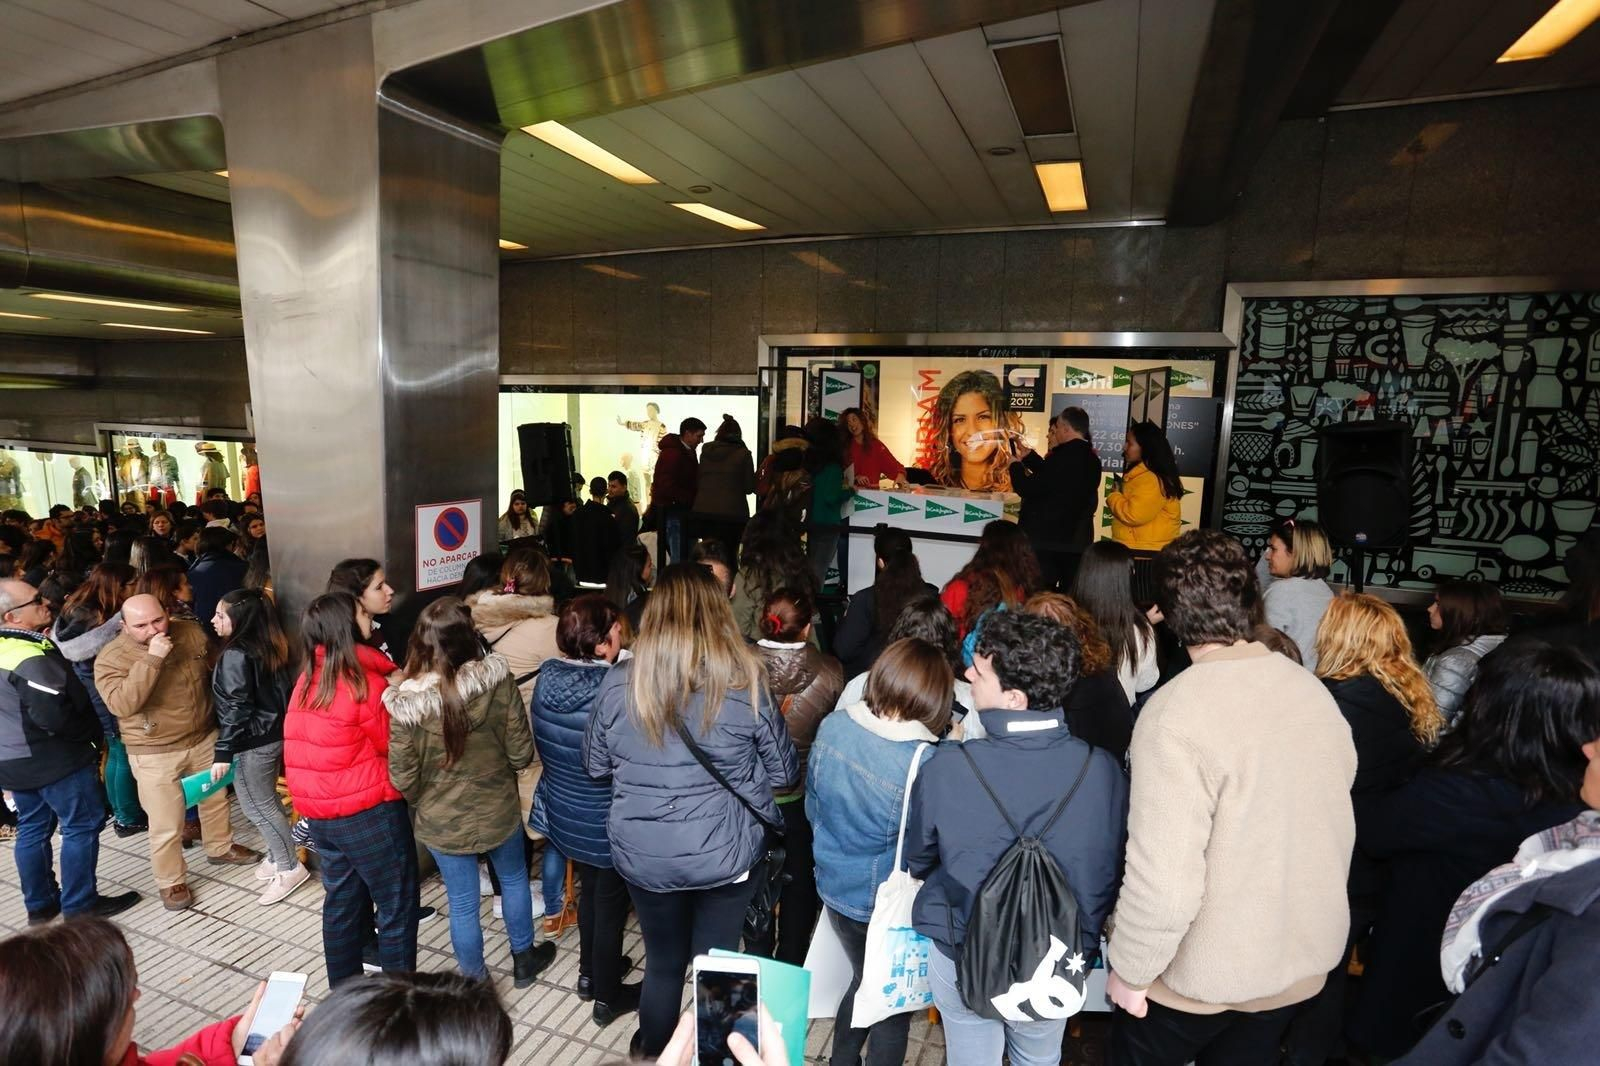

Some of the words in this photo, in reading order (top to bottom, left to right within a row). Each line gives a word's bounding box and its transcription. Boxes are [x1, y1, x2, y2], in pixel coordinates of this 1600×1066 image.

[1010, 398, 1034, 406] 2017
[1092, 430, 1107, 440] 22
[1110, 431, 1125, 441] de
[1092, 441, 1122, 452] 17.30
[1174, 445, 1185, 455] h.
[422, 558, 437, 568] NO
[439, 550, 478, 565] APARCAR
[428, 568, 439, 576] DE
[440, 562, 466, 574] COLUMN
[426, 574, 449, 584] HACIA
